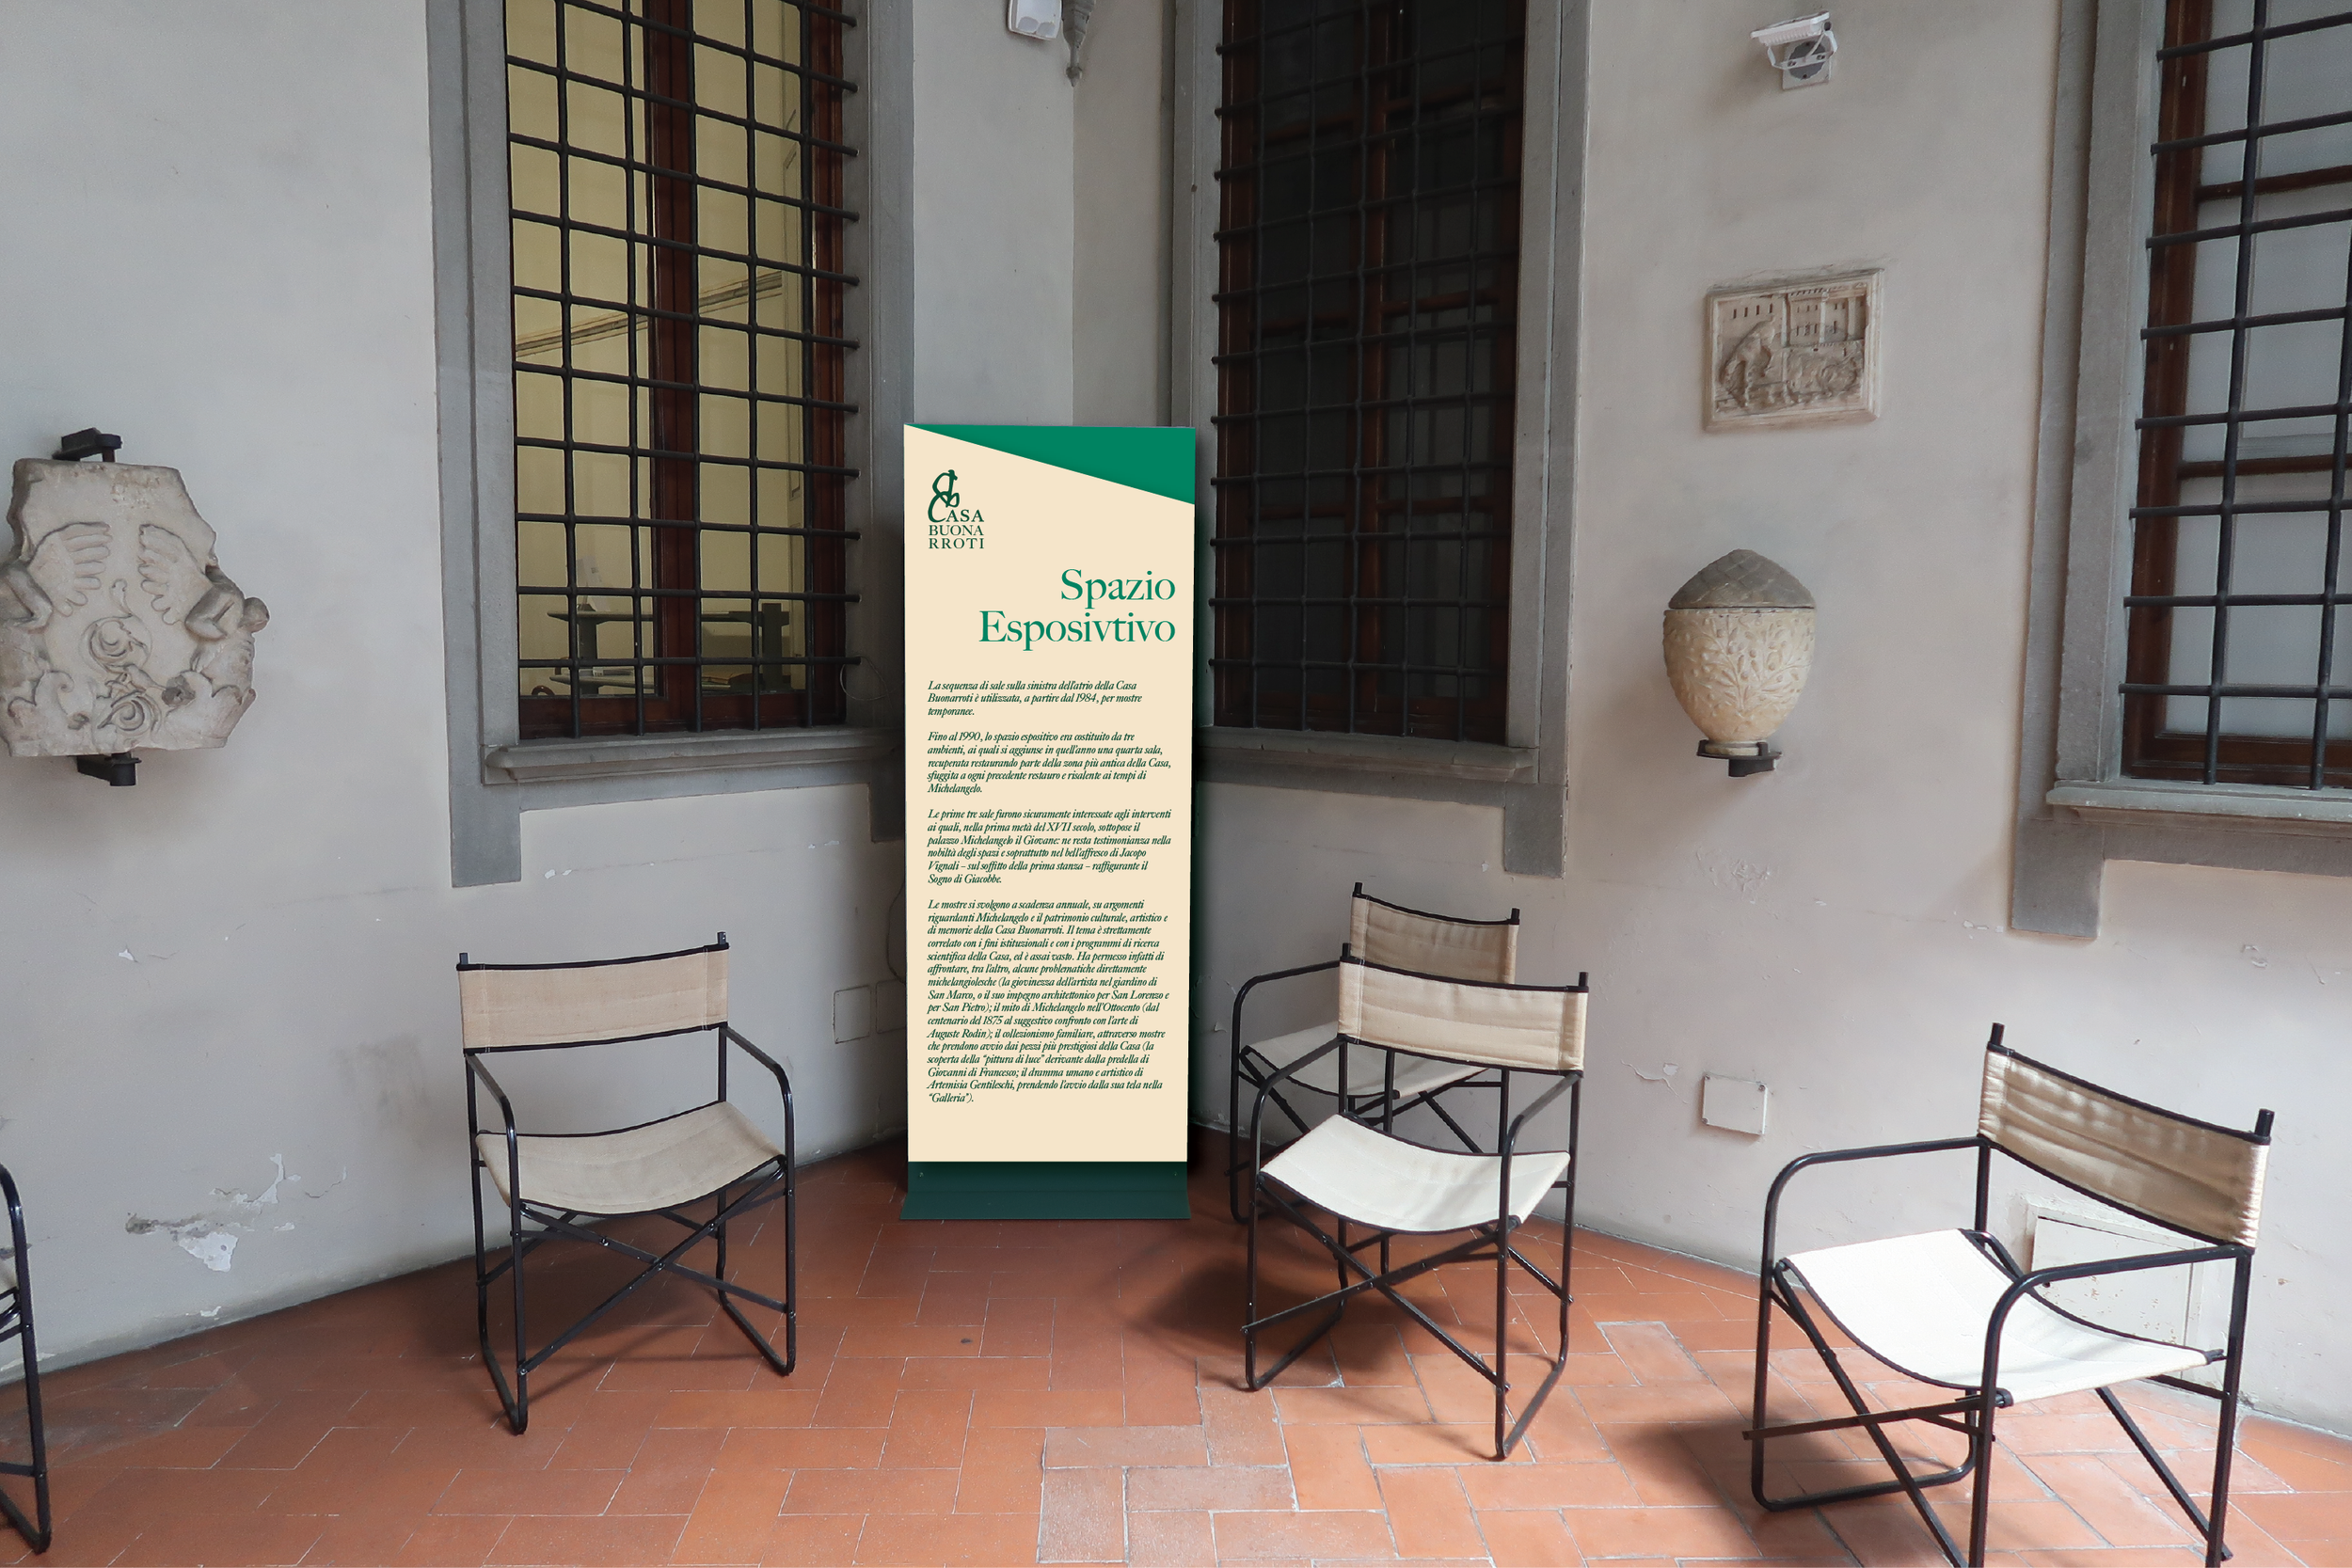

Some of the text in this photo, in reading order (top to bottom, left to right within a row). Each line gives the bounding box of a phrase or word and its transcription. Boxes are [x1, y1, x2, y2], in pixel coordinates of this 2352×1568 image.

[928, 486, 984, 523] CASA
[929, 524, 984, 536] BUONA
[929, 537, 984, 549] RROTI
[1061, 568, 1176, 610] Spazio
[978, 610, 1176, 652] Esposivtivo
[928, 681, 941, 689] La
[942, 684, 978, 692] sequenza
[979, 681, 989, 689] di
[990, 681, 1005, 689] sale
[1006, 681, 1025, 689] sulla
[1026, 681, 1057, 689] sinistra
[1094, 681, 1114, 689] della
[1116, 681, 1136, 689] Casa
[928, 693, 974, 702] Buonarroti
[981, 693, 1022, 704] utilizzata,
[1030, 693, 1059, 705] partire
[1060, 693, 1074, 702] dal
[1075, 693, 1099, 704] 1984,
[1100, 696, 1115, 705] per
[928, 707, 974, 718] temporanee.
[928, 732, 947, 740] Fino
[948, 732, 958, 741] al
[959, 732, 982, 742] 1990,
[985, 732, 993, 741] lo
[993, 732, 1019, 743] spazio
[1021, 732, 1058, 743] espositivo
[1074, 732, 1110, 740] costituito
[1111, 732, 1121, 740] da
[928, 745, 965, 755] ambienti,
[968, 745, 977, 753] ai
[978, 745, 1000, 756] quali
[1000, 745, 1008, 753] si
[1009, 745, 1043, 756] aggiunse
[1045, 745, 1054, 753] in
[1116, 747, 1143, 756] quarta
[1144, 745, 1162, 755] sala,
[929, 760, 969, 769] recuperata
[971, 758, 1018, 767] restaurando
[1019, 760, 1041, 769] parte
[1042, 758, 1061, 768] della
[1084, 758, 1099, 769] più
[1100, 758, 1125, 767] antica
[1127, 758, 1146, 768] della
[1149, 758, 1170, 768] Casa,
[928, 784, 982, 795] Michelangelo.
[928, 809, 940, 818] Le
[940, 809, 965, 820] prime
[978, 809, 994, 818] sale
[993, 809, 1022, 820] furono
[1023, 809, 1071, 818] sicuramente
[1073, 809, 1113, 818] interessate
[1114, 809, 1130, 821] agli
[1132, 809, 1171, 818] interventi
[927, 835, 959, 847] palazzo
[961, 835, 1013, 847] Michelangelo
[1015, 835, 1022, 845] il
[1024, 835, 1060, 845] Giovane:
[1093, 835, 1150, 845] testimonianza
[1152, 835, 1171, 845] nella
[929, 861, 960, 873] Vignali
[967, 861, 980, 870] sul
[980, 861, 1007, 873] soffitto
[1009, 861, 1027, 870] della
[1029, 861, 1055, 873] prima
[1092, 861, 1140, 873] raffigurante
[1141, 861, 1148, 870] il
[928, 874, 1001, 886] Sogno di Giacobbe.
[929, 900, 940, 909] Le
[968, 900, 976, 909] si
[977, 900, 1010, 911] svolgono
[1018, 900, 1054, 909] scadenza
[1056, 900, 1090, 910] annuale,
[1104, 900, 1144, 911] argomenti
[928, 926, 937, 934] di
[938, 926, 973, 934] memorie
[974, 926, 993, 934] della
[995, 926, 1015, 934] Casa
[1018, 926, 1064, 934] Buonarroti.
[1067, 926, 1074, 934] Il
[1097, 926, 1102, 934] è
[928, 964, 969, 975] affrontare,
[1012, 964, 1039, 973] alcune
[1040, 964, 1095, 975] problematiche
[1096, 964, 1147, 973] direttamente
[928, 977, 996, 989] michelangiolesche
[999, 977, 1010, 987] (la
[1010, 977, 1055, 989] giovinezza
[1100, 977, 1113, 986] nel
[1112, 977, 1147, 989] giardino
[1149, 977, 1157, 986] di
[927, 1006, 941, 1014] per
[943, 1003, 960, 1012] San
[961, 1003, 992, 1013] Pietro);
[993, 1003, 1000, 1011] il
[1001, 1003, 1020, 1011] mito
[1022, 1003, 1031, 1011] di
[1032, 1003, 1085, 1014] Michelangelo
[1142, 1003, 1160, 1012] (dal
[927, 1029, 960, 1040] Auguste
[961, 1029, 993, 1039] Rodin);
[994, 1029, 1001, 1037] il
[1003, 1029, 1054, 1037] collezionismo
[1054, 1029, 1095, 1040] familiare,
[929, 1068, 967, 1077] Giovanni
[968, 1068, 977, 1076] di
[978, 1068, 1019, 1078] Francesco;
[1021, 1068, 1027, 1077] il
[1028, 1068, 1063, 1076] dramma
[1101, 1068, 1133, 1076] artistico
[1135, 1068, 1144, 1076] di
[927, 1080, 967, 1088] Artemisia
[970, 1080, 1014, 1090] Gentileschi,
[1016, 1080, 1058, 1091] prendendo
[1088, 1080, 1109, 1089] dalla
[1126, 1080, 1141, 1089] tela
[1143, 1080, 1163, 1089] nella
